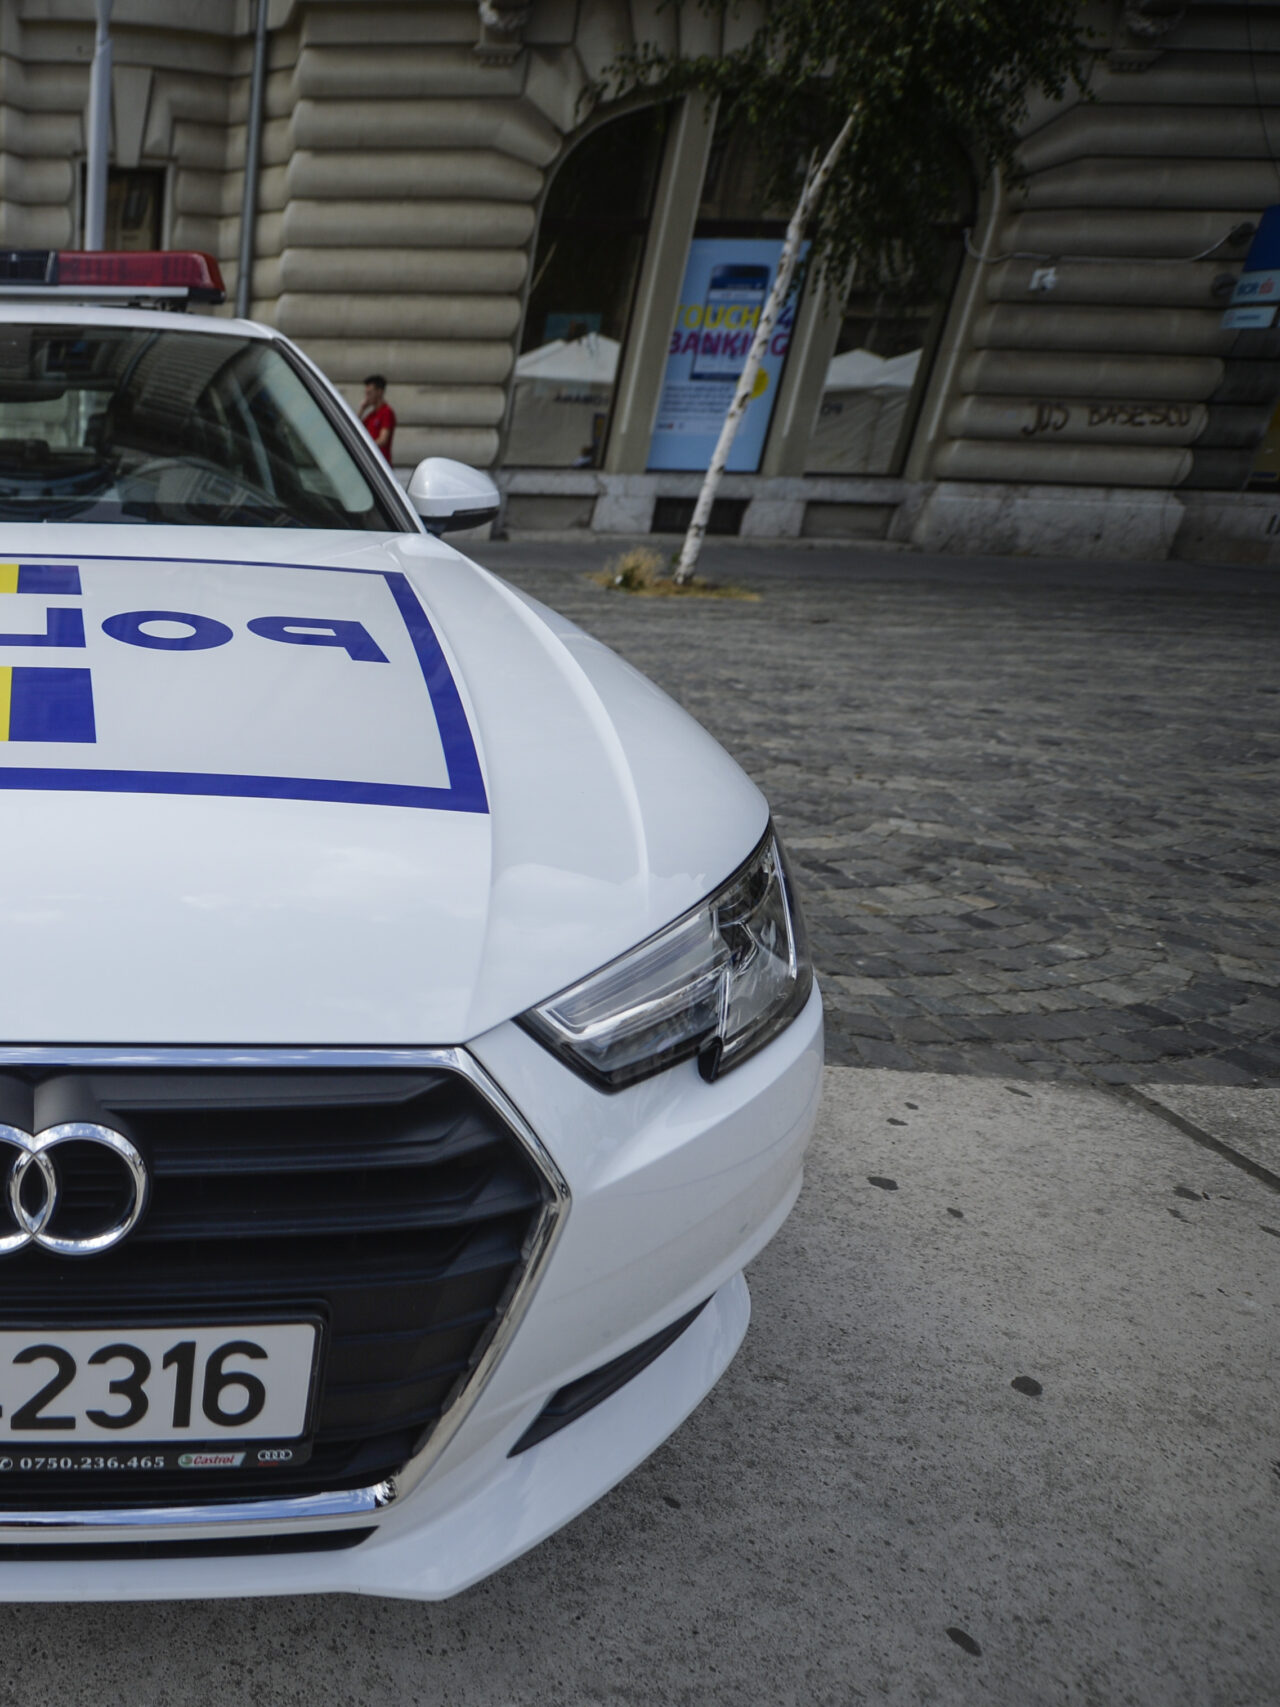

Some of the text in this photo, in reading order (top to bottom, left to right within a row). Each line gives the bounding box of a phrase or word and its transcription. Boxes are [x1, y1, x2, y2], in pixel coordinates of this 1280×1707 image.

[669, 330, 790, 357] BANKIG
[20, 1456, 165, 1470] 0750.236.465
[193, 1454, 235, 1465] Castrol
